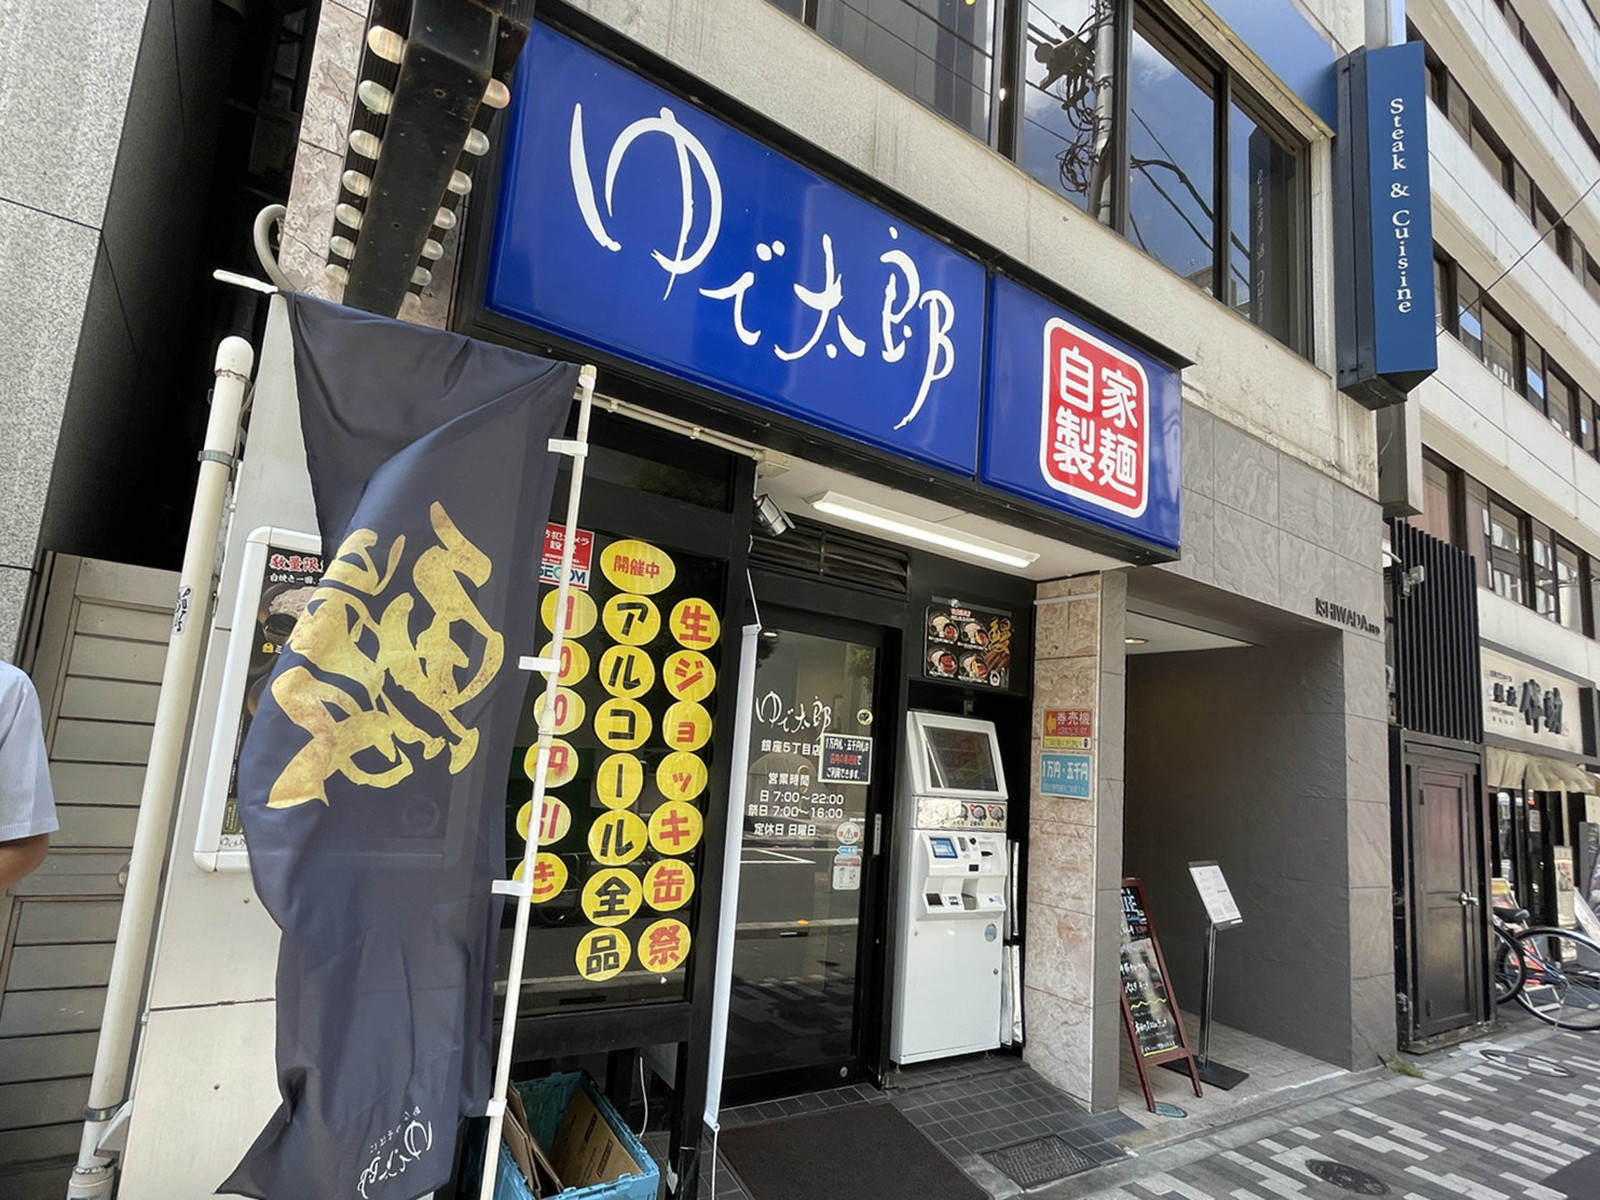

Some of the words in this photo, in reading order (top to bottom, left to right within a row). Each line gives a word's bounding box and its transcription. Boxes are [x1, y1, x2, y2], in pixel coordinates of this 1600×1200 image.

[1390, 98, 1406, 170] Steak
[1391, 182, 1410, 198] &
[570, 103, 956, 430] ゆで太郎
[1392, 210, 1412, 313] Cuisine
[1060, 346, 1138, 429] 自家
[1053, 405, 1138, 497] 製麺
[269, 554, 324, 573] 数量限
[613, 555, 660, 578] 開催中
[756, 690, 831, 741] ゆで太郎
[1057, 711, 1091, 726] 券売機
[761, 739, 821, 756] 銀座5丁目店
[586, 602, 649, 976] アルコール全品
[649, 605, 711, 966] 生ジョッキ缶祭
[768, 772, 810, 786] 営業時間
[748, 804, 769, 816] 祭日
[754, 823, 784, 836] 定休日
[788, 824, 816, 836] 日曜日
